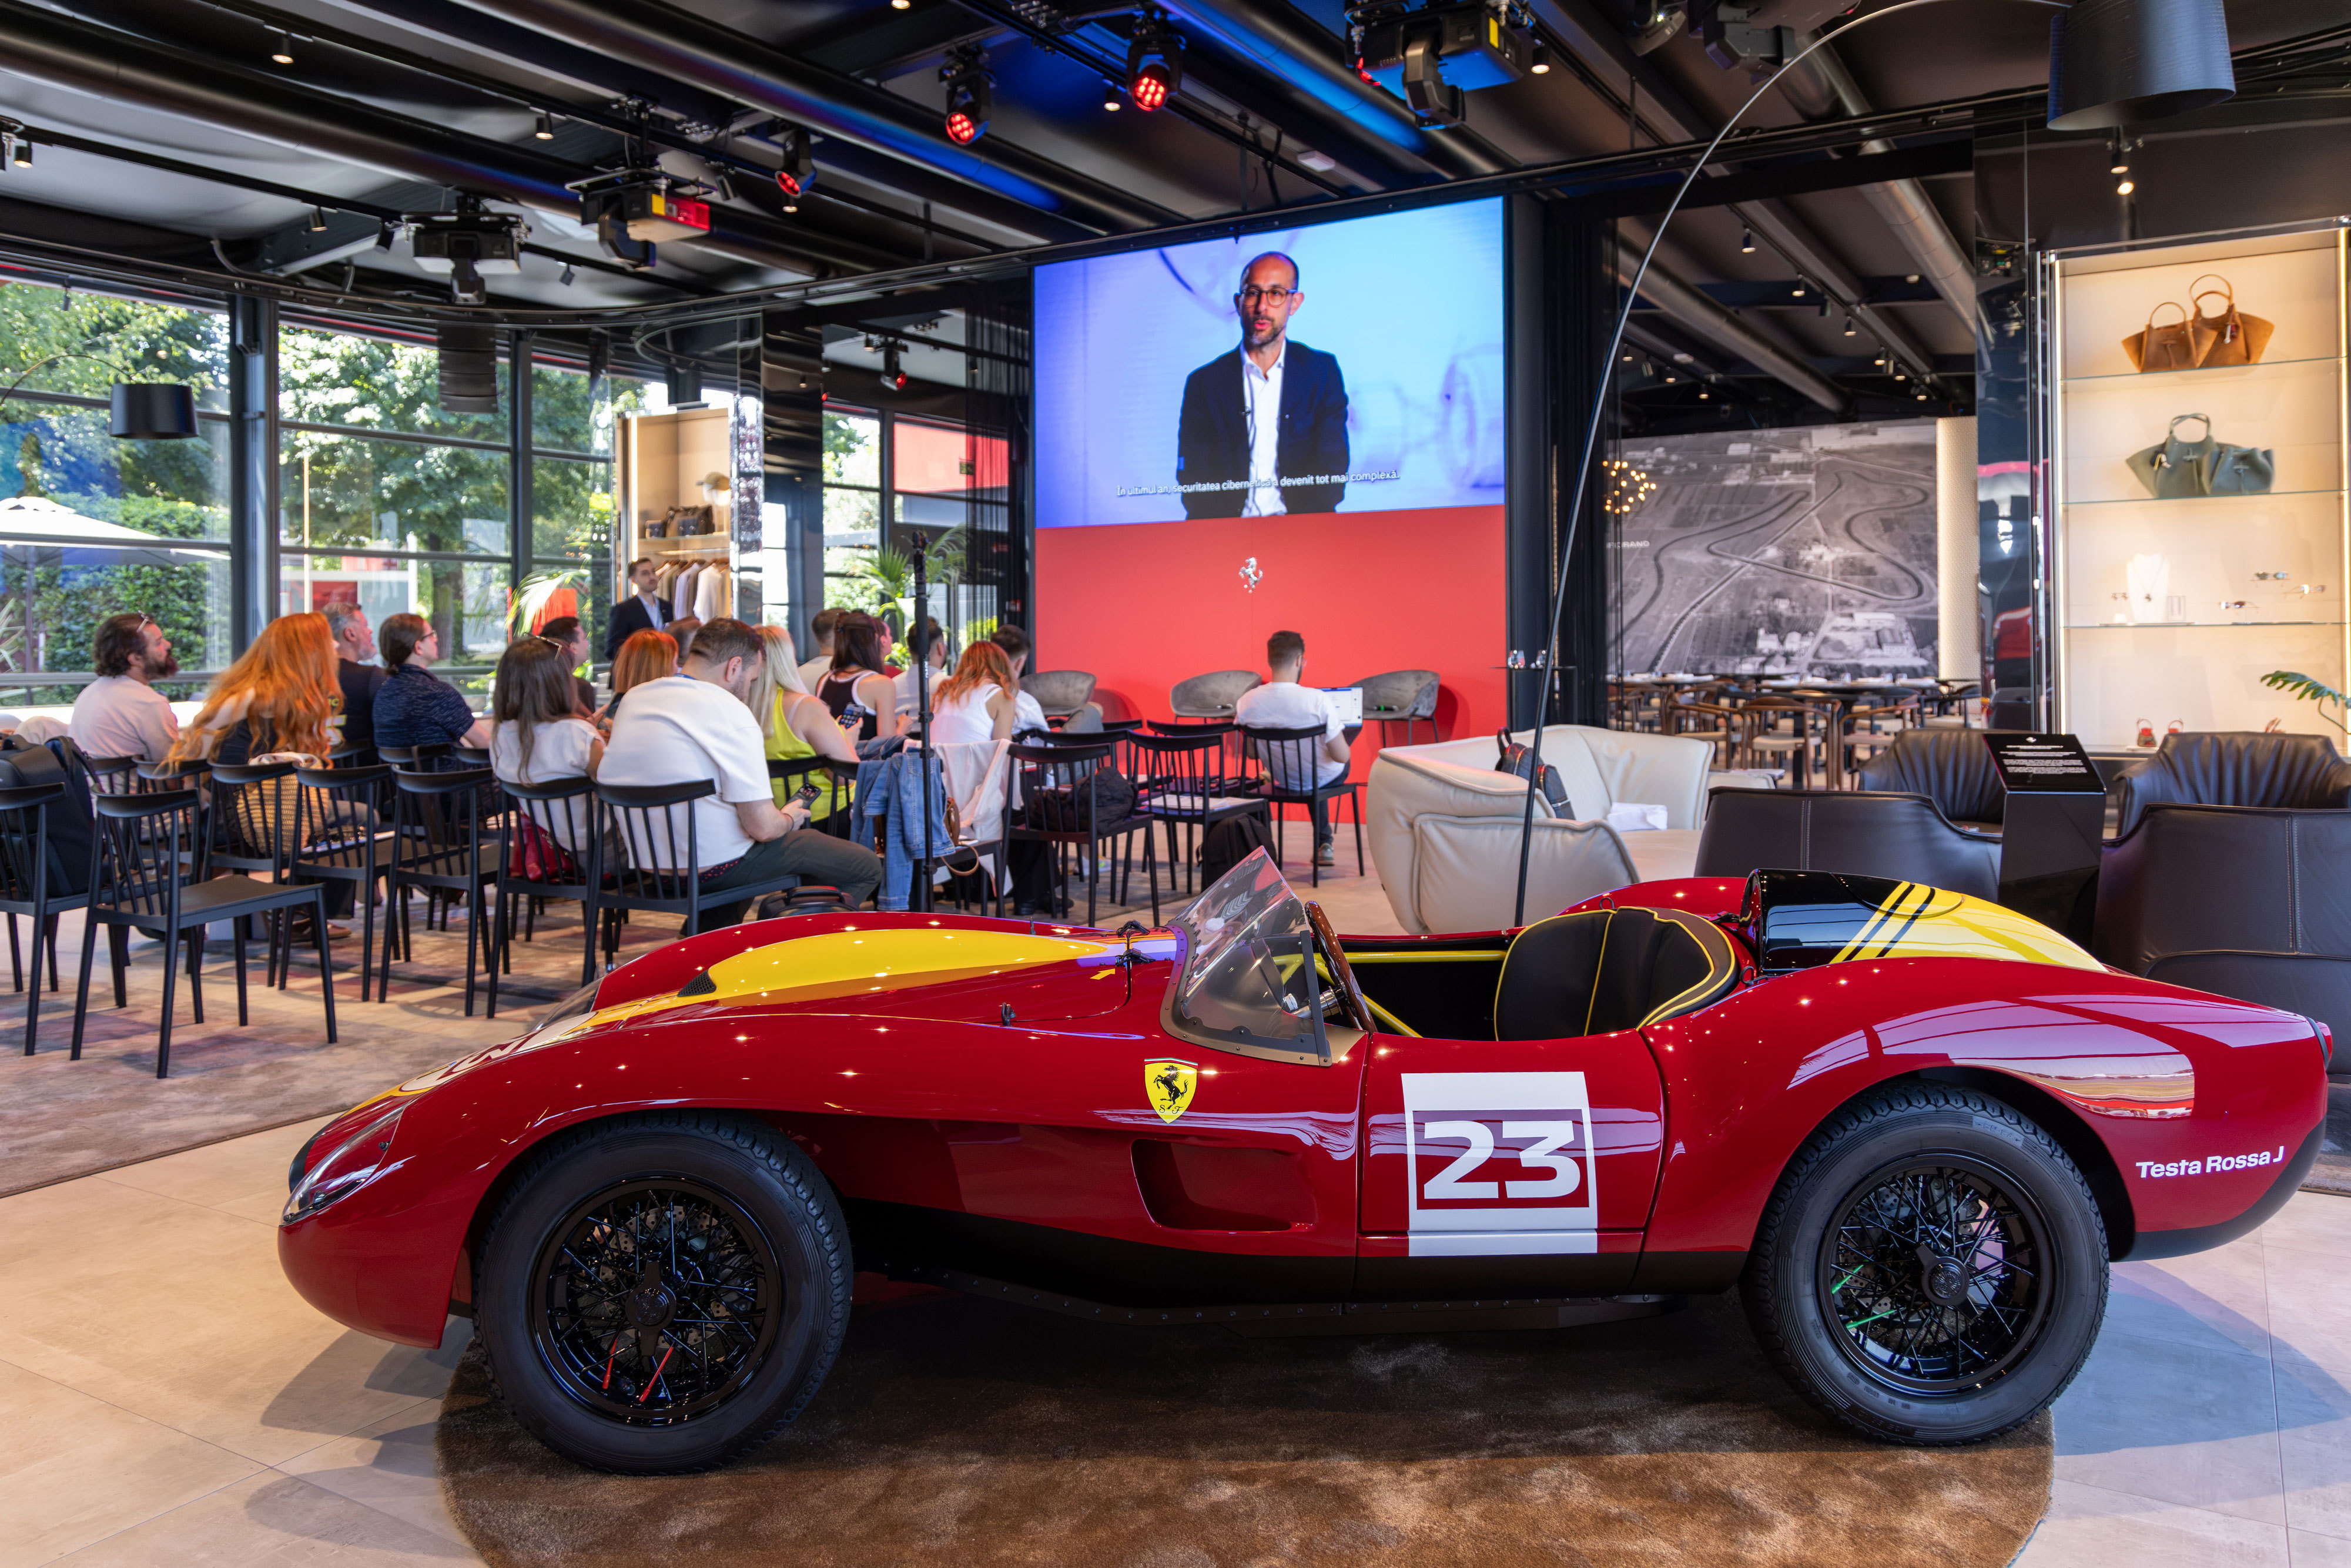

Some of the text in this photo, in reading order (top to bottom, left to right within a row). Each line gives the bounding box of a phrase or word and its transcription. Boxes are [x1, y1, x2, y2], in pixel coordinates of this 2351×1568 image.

[1117, 485, 1126, 496] În
[1127, 485, 1156, 495] ultimul
[1173, 482, 1220, 494] securitatea
[1280, 475, 1314, 487] devenit
[1315, 474, 1329, 484] tot
[1331, 473, 1348, 484] mai
[1158, 1104, 1166, 1113] S
[1424, 1120, 1581, 1200] 23
[2135, 1145, 2285, 1178] Testa Rossa J
